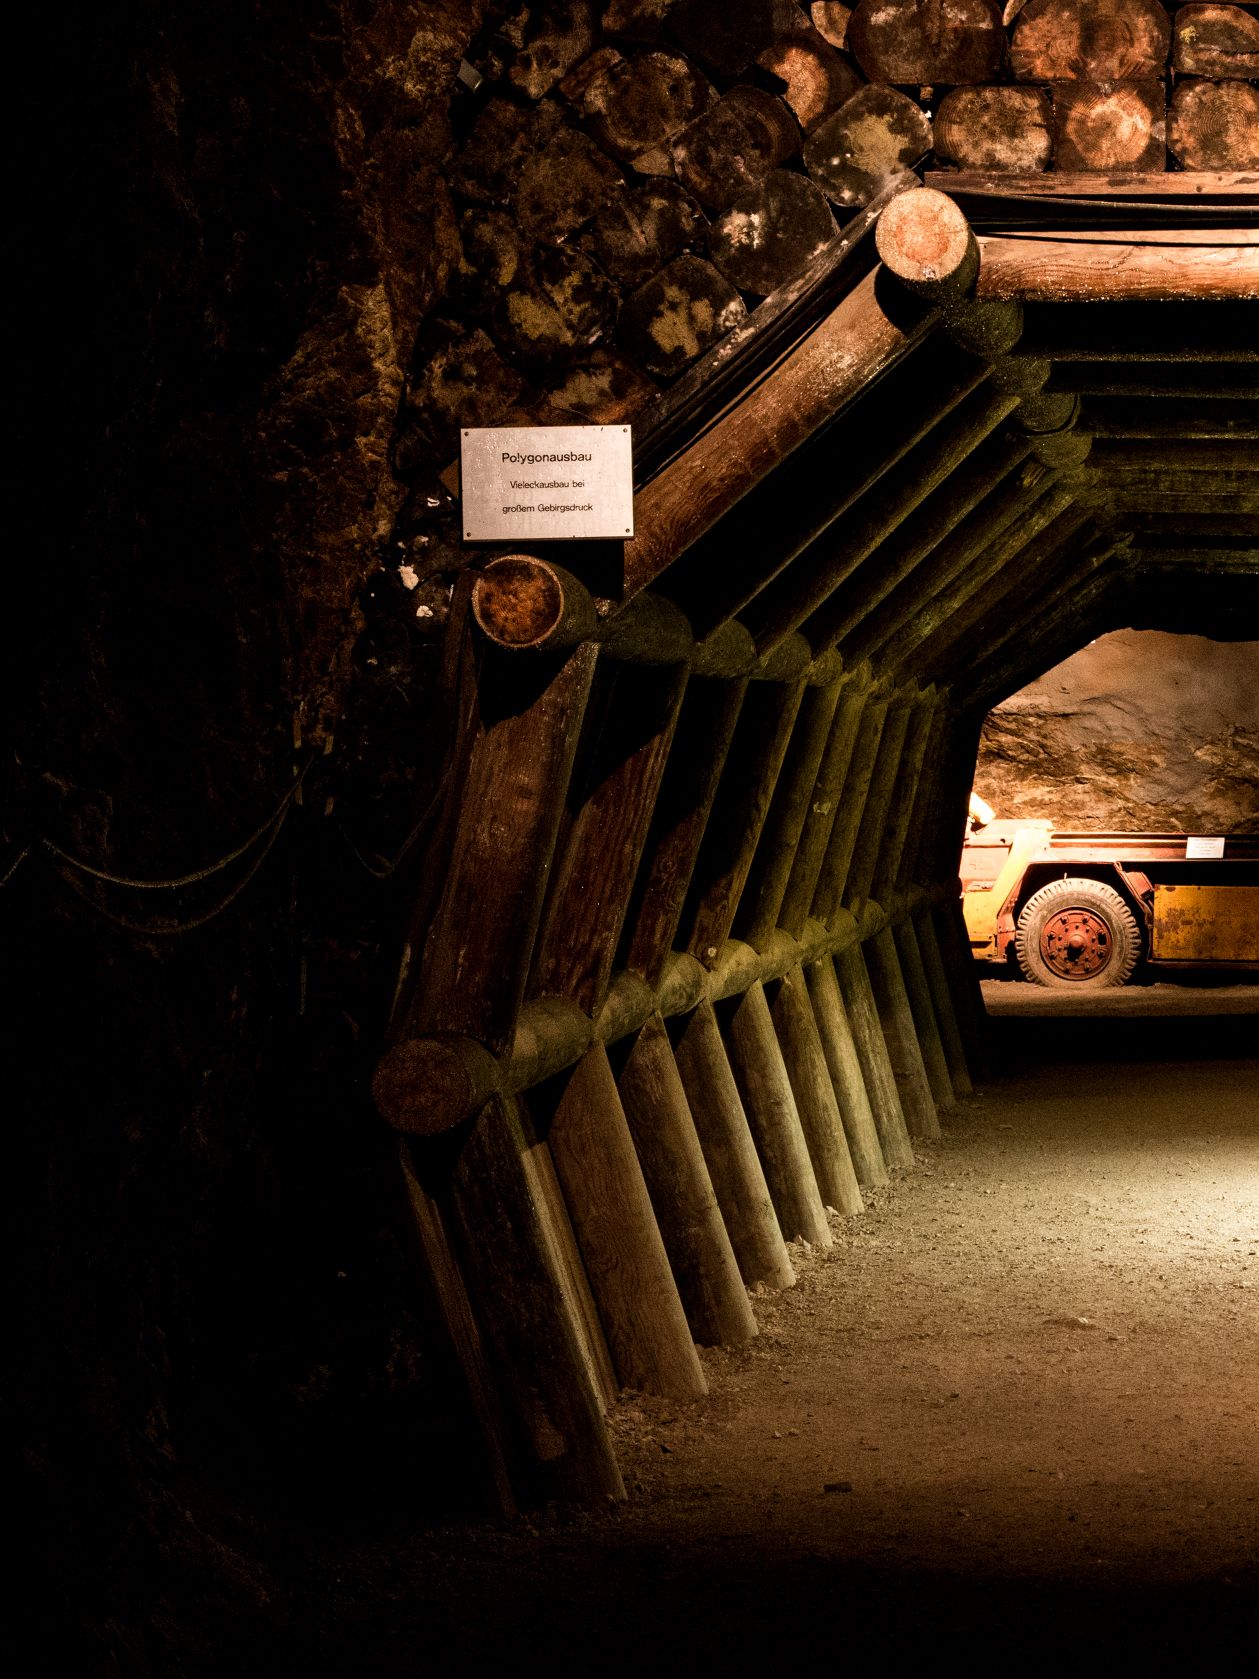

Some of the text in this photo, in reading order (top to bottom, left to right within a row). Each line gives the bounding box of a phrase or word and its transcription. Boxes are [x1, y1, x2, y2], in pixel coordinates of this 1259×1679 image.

[501, 451, 592, 465] Polygonausbau
[510, 479, 585, 489] Vieleckausbau bei
[502, 503, 593, 514] großem Gebirgsdruck
